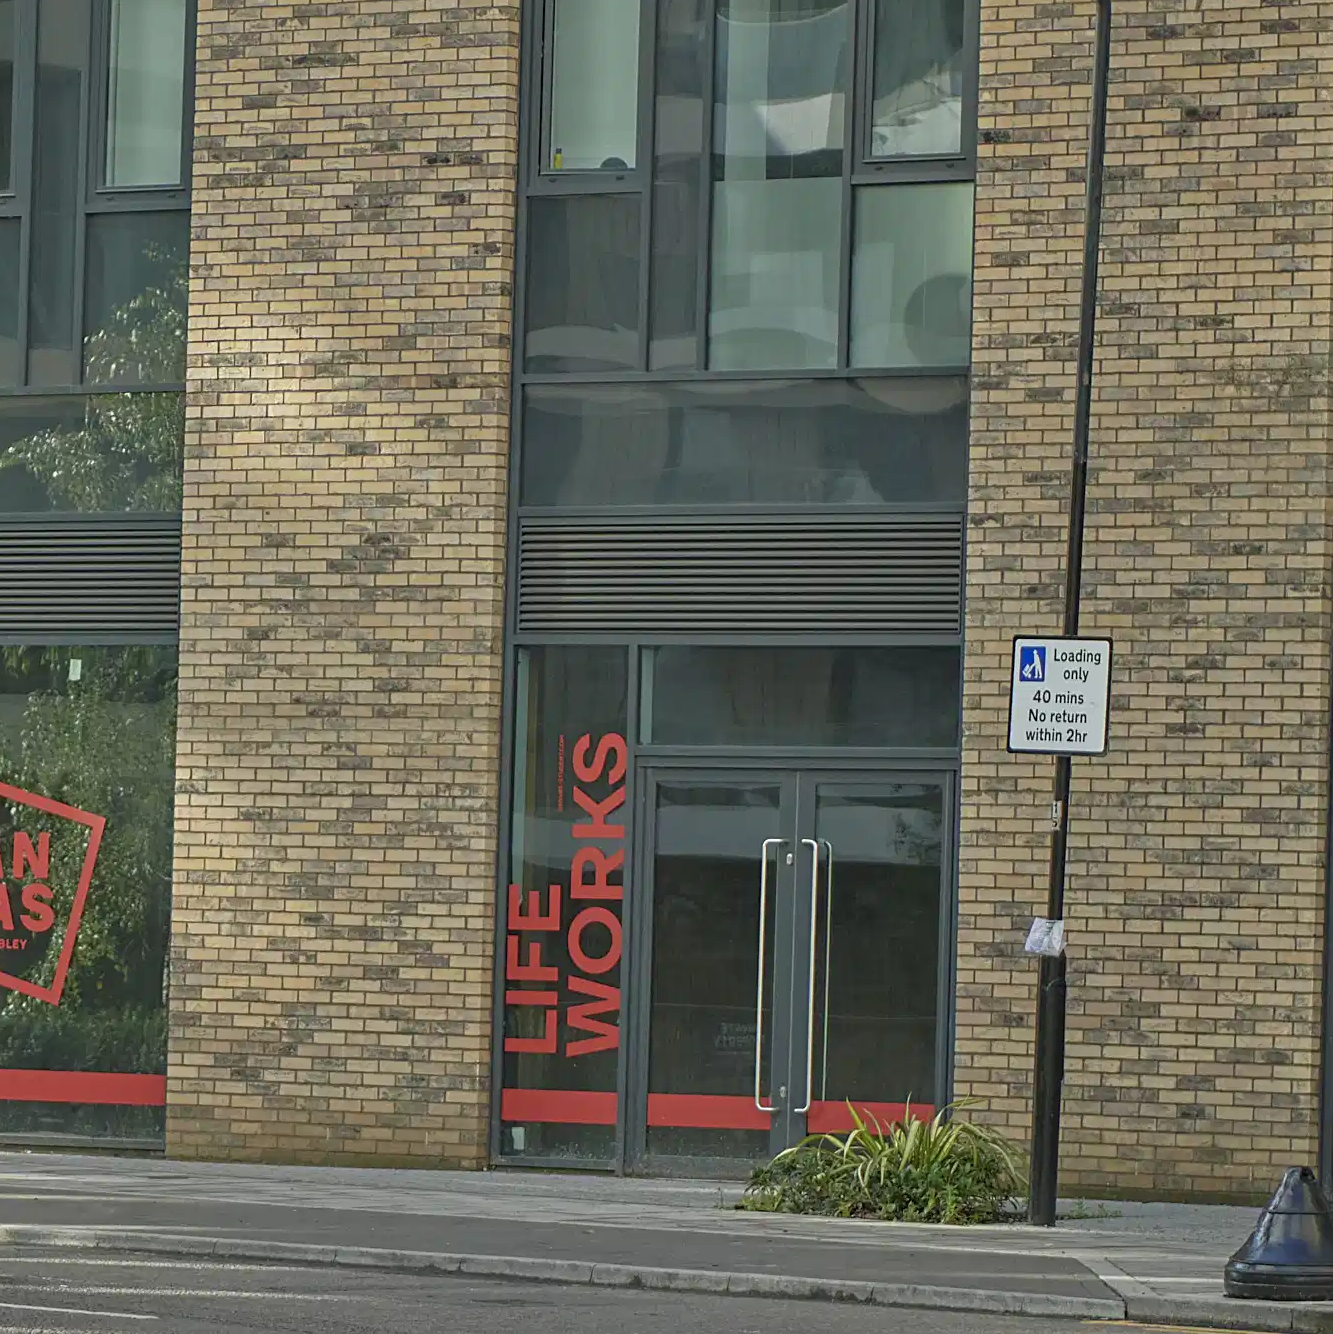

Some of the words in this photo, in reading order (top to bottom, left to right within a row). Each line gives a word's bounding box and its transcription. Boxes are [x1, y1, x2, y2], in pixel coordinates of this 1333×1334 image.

[1053, 648, 1101, 665] Loading
[1063, 667, 1089, 683] only
[1033, 689, 1051, 704] 40
[1055, 691, 1084, 704] mins
[1028, 708, 1046, 722] No
[1050, 710, 1087, 724] return
[1026, 727, 1062, 741] within
[1066, 728, 1088, 742] 2hr
[566, 732, 628, 1058] WORKS
[504, 883, 561, 1054] LIFE
